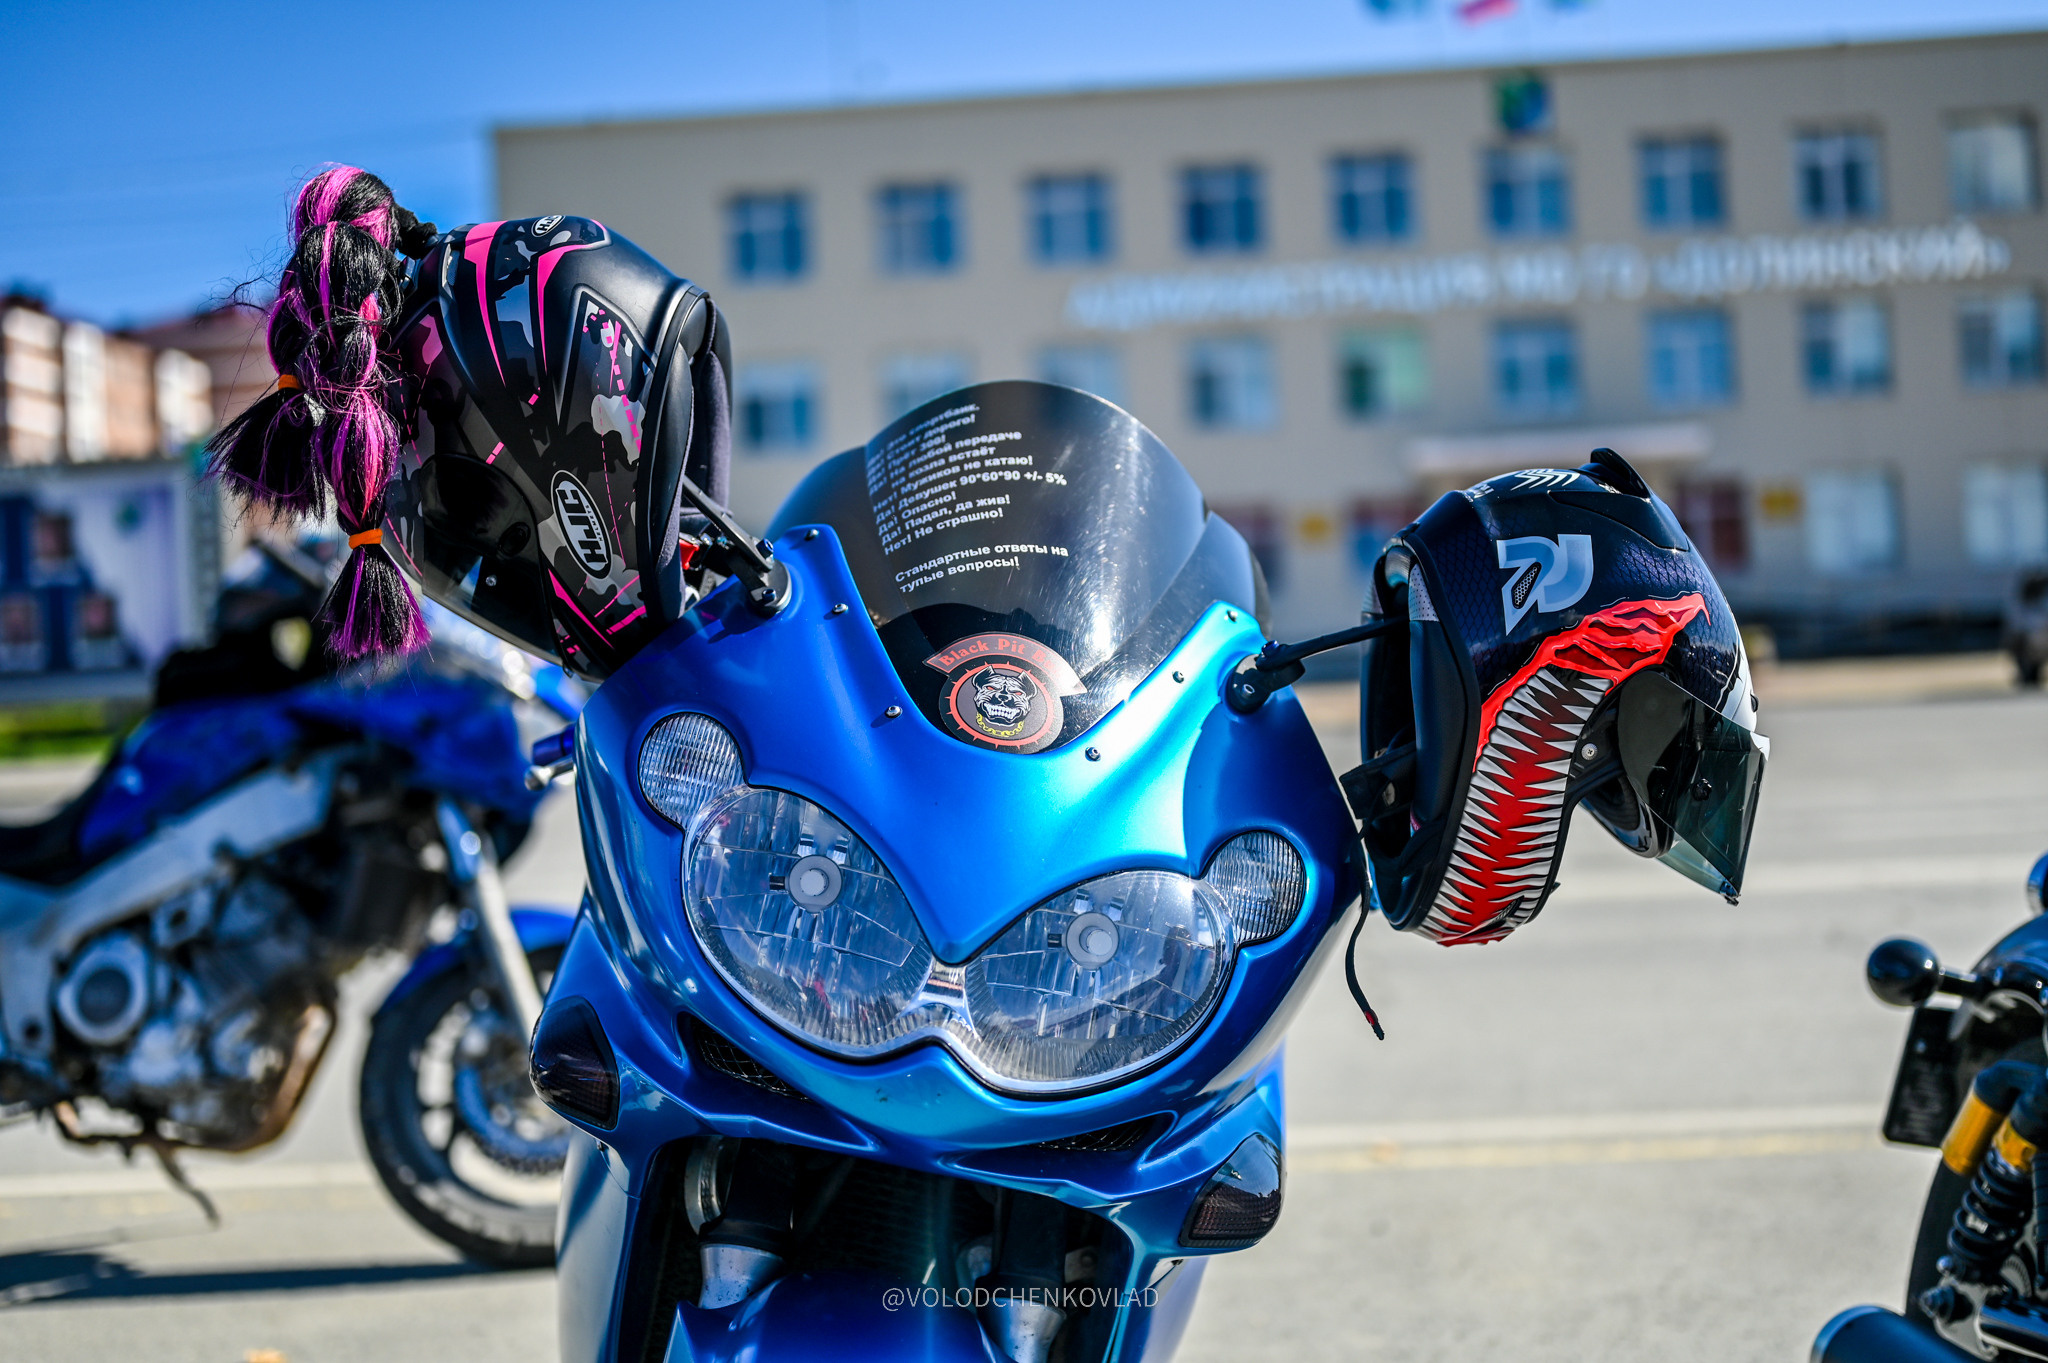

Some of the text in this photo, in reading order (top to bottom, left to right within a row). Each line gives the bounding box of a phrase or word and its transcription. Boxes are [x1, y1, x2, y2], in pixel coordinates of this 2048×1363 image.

[955, 430, 1022, 450] передаче
[901, 465, 961, 495] Мужиков
[963, 460, 982, 472] не
[984, 455, 1033, 468] катаю!
[909, 458, 946, 479] козла
[948, 445, 997, 463] встаёт
[898, 480, 957, 511] Девушек
[1045, 472, 1067, 486] 5%
[556, 489, 608, 563] HJC
[878, 491, 957, 537] Да! Опасно!
[881, 494, 1011, 547] Да! Падал, да жив!
[884, 507, 1004, 556] Нет! Не страшно!
[895, 544, 1069, 583] Стандартные ответы на
[899, 556, 1021, 593] тупые вопросы!
[938, 640, 990, 667] Black
[998, 638, 1027, 655] Pit
